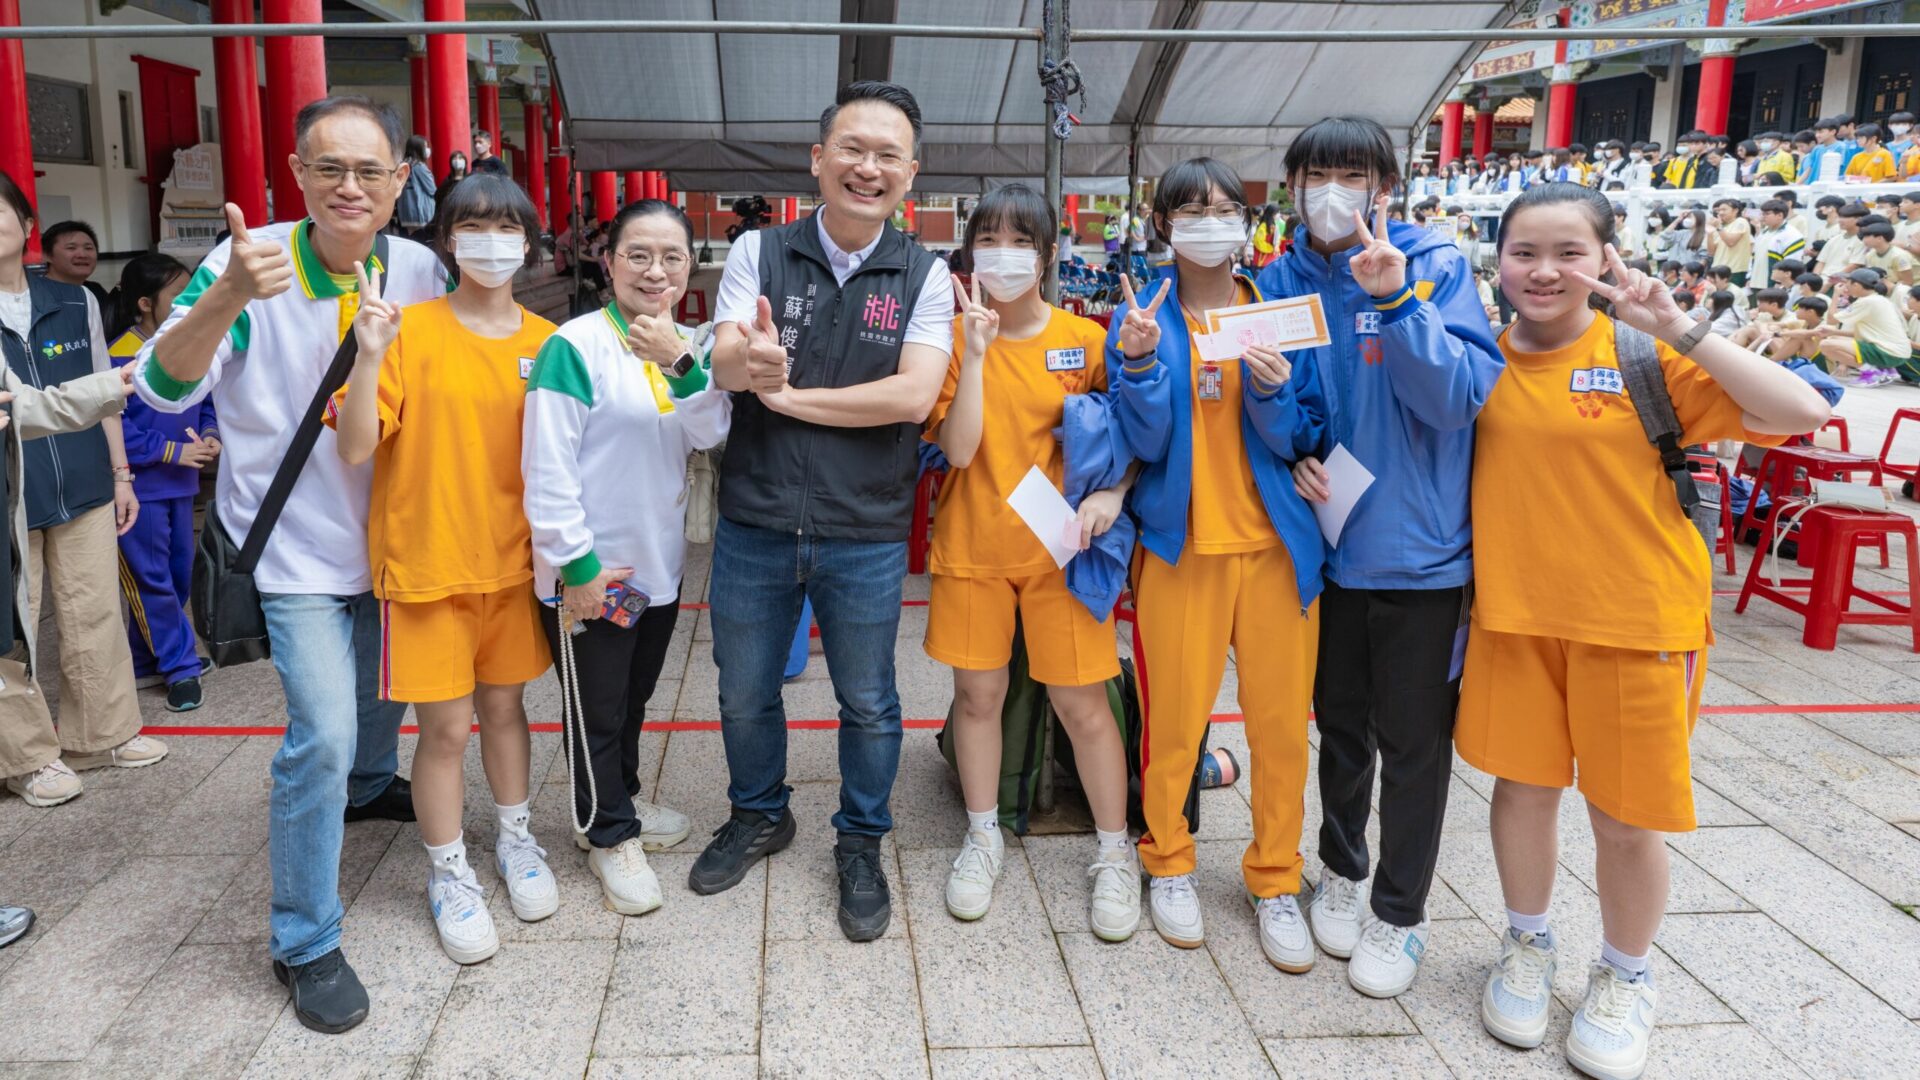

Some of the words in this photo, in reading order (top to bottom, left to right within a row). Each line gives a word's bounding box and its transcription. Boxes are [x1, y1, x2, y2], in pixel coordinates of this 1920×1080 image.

[803, 283, 817, 326] 副市長
[64, 338, 88, 351] 民政局
[1576, 376, 1584, 385] 8
